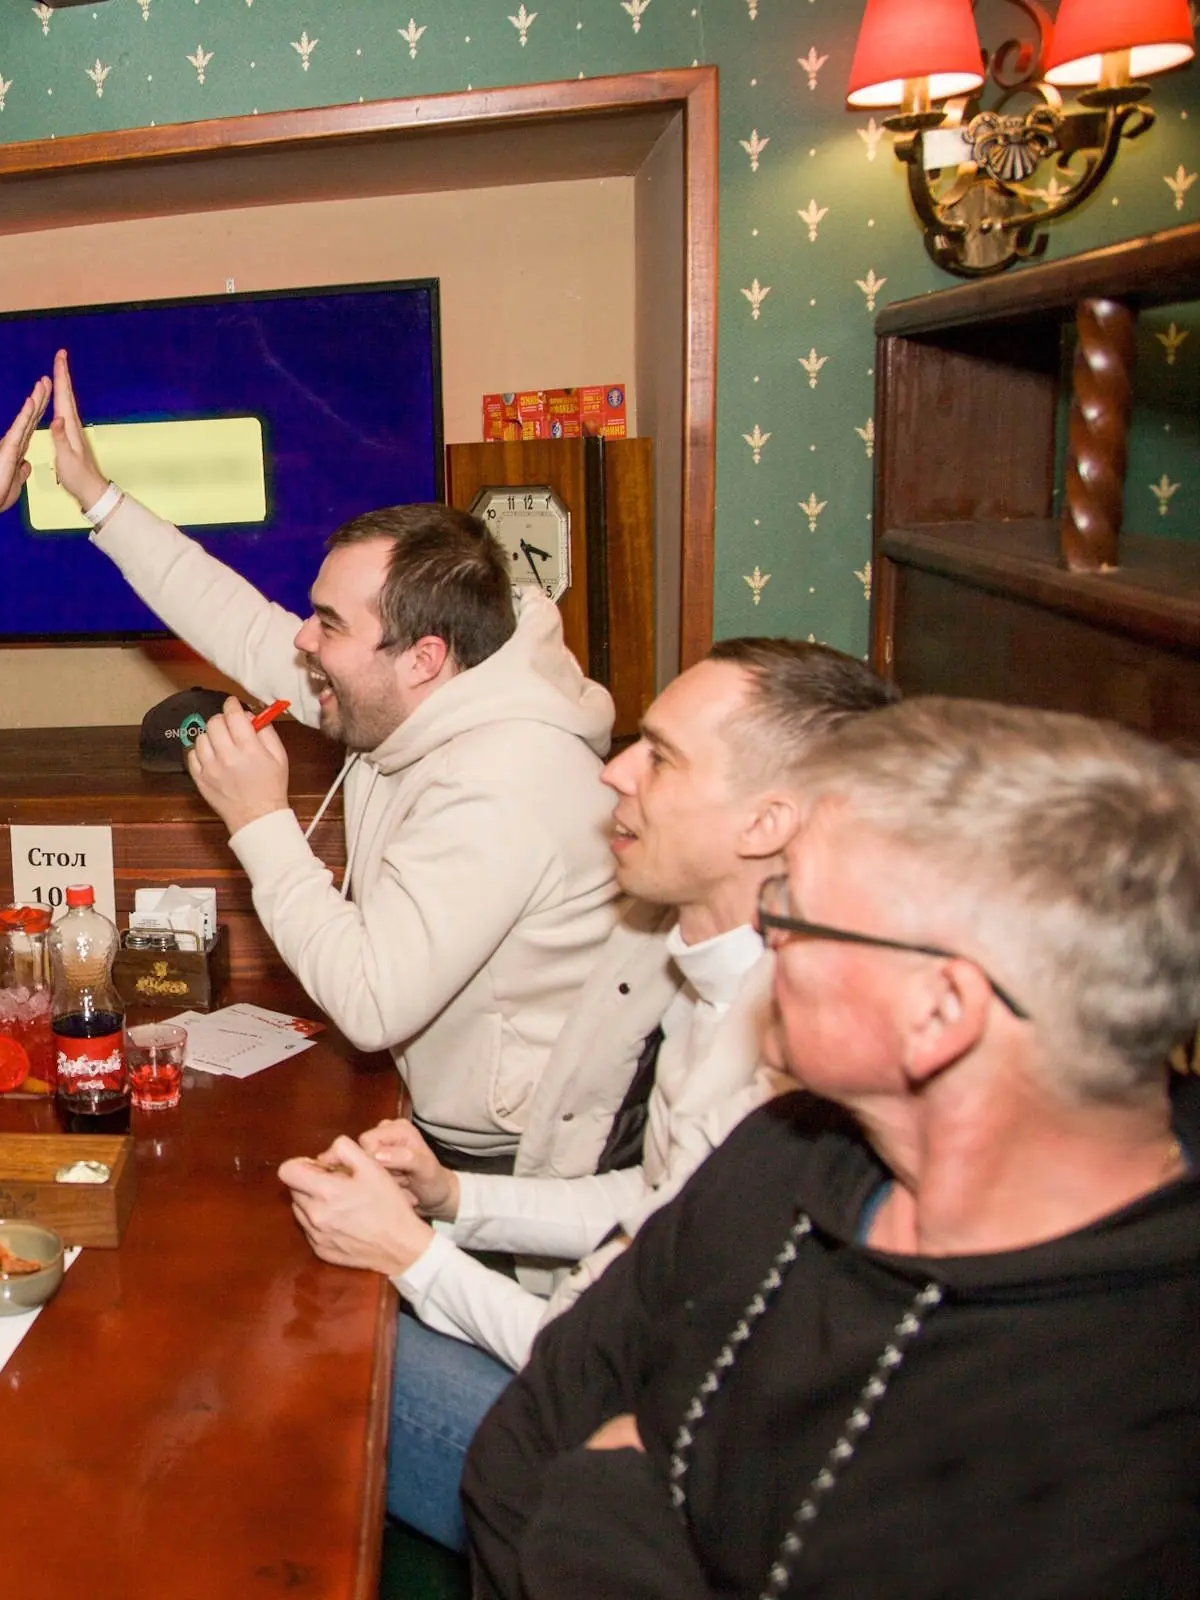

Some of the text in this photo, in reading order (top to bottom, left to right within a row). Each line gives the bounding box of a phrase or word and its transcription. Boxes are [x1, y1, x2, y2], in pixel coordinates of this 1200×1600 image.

[523, 495, 533, 510] 12
[486, 509, 496, 520] 10
[546, 585, 553, 598] 5
[28, 847, 87, 867] Стол
